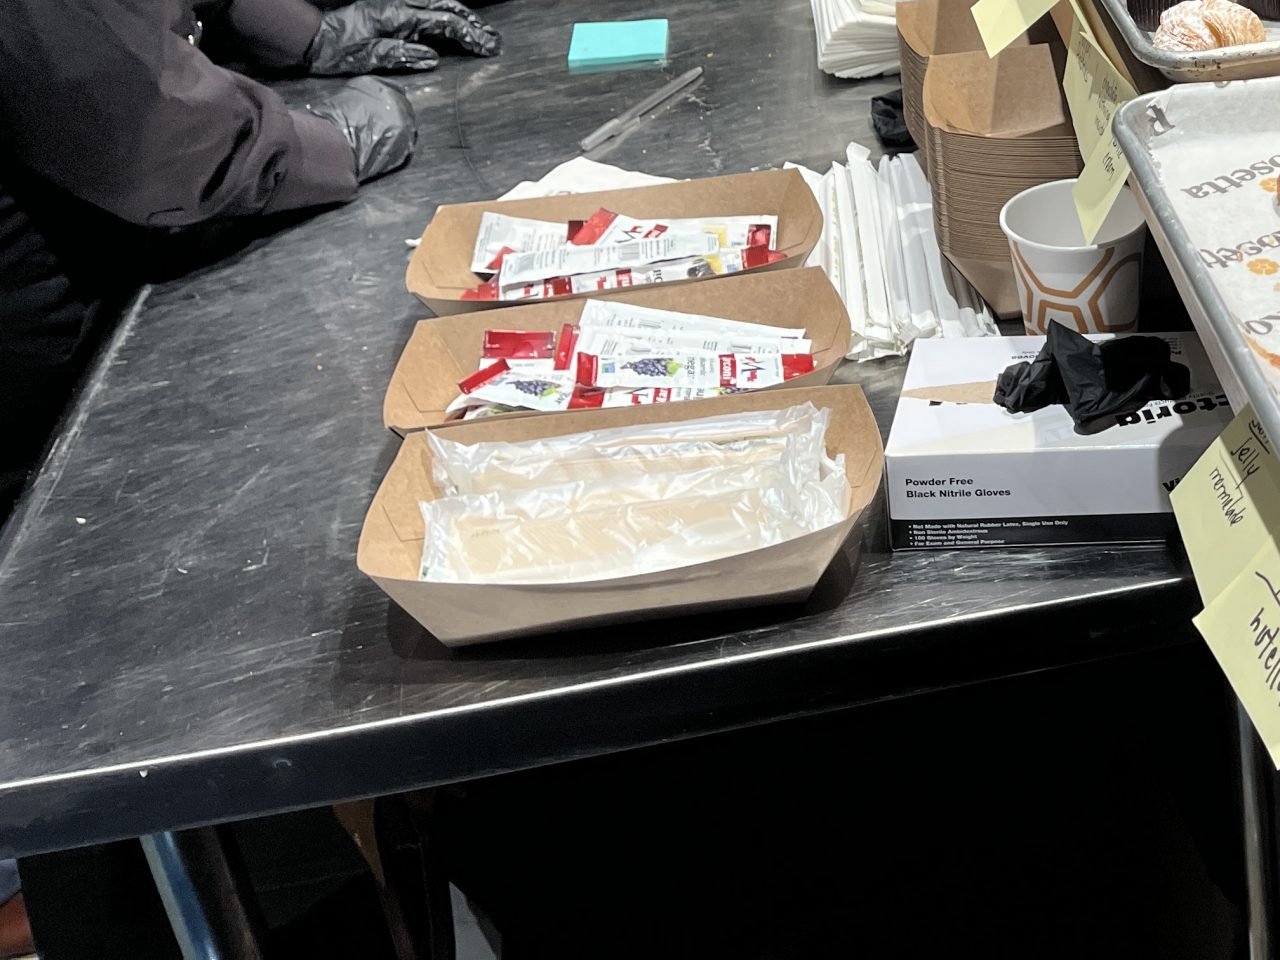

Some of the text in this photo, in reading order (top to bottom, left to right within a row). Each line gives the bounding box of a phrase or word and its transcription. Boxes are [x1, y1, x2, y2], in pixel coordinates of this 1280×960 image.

[905, 477, 974, 487] Powder Free
[906, 488, 1011, 498] Black Nitrile Gloves
